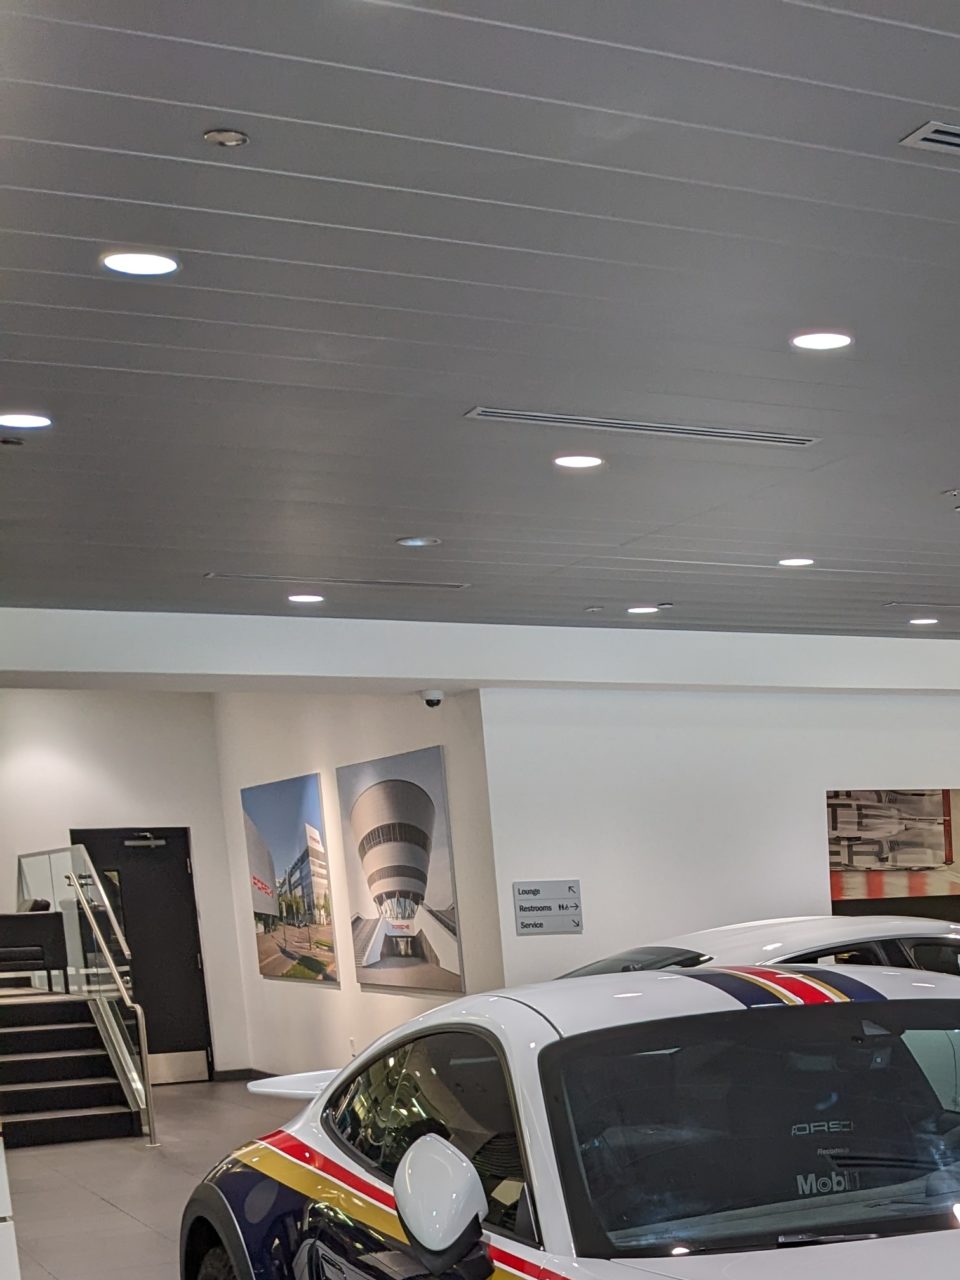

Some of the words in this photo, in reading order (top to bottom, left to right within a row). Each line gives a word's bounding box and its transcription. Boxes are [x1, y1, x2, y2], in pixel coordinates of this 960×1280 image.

[518, 888, 541, 896] Lounge
[519, 904, 552, 912] Restrooms
[520, 921, 544, 929] Service
